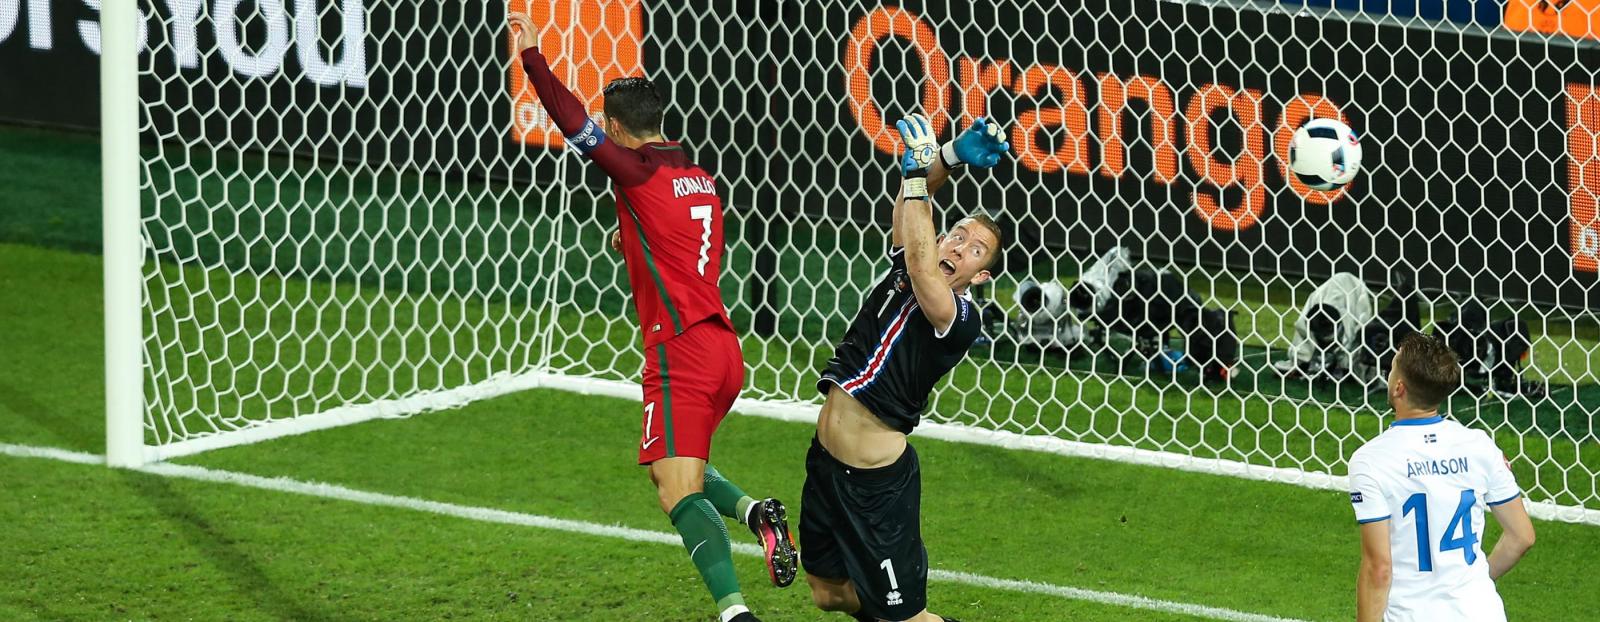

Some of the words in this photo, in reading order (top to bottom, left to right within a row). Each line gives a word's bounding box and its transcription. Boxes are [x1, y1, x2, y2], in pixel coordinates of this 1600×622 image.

[0, 0, 367, 88] You
[672, 175, 716, 199] RONALDO
[689, 204, 713, 277] 7
[877, 288, 896, 319] 1
[1402, 488, 1480, 572] 14
[879, 557, 899, 590] 1
